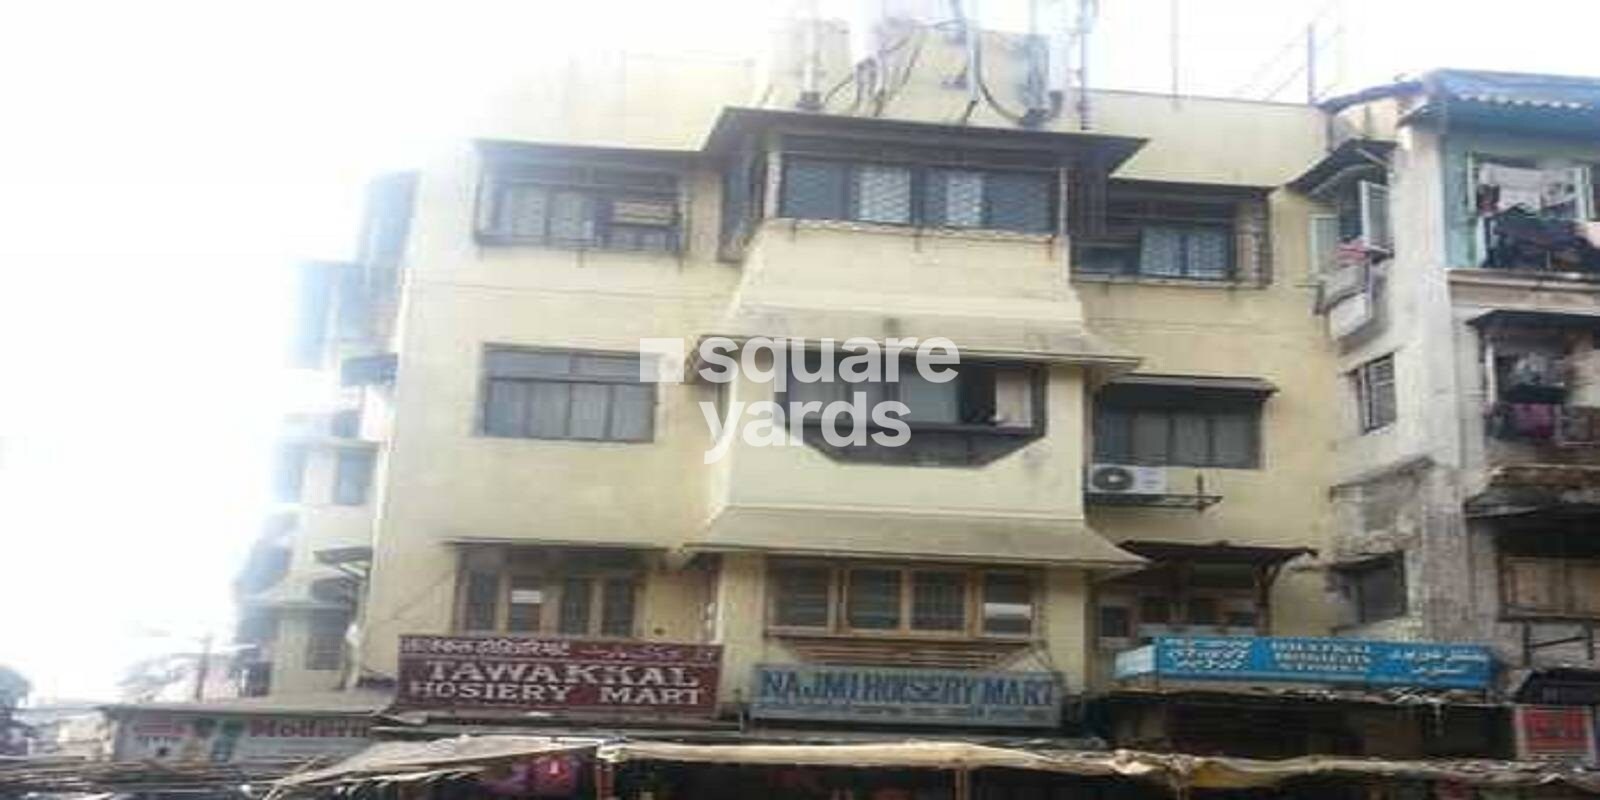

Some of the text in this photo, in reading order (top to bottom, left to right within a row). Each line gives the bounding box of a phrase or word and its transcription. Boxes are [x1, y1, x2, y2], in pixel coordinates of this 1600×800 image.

[425, 660, 700, 687] TAWAKKAL
[409, 680, 701, 705] HOSIERY MART
[983, 676, 1053, 706] MART
[250, 718, 371, 739] Modern
